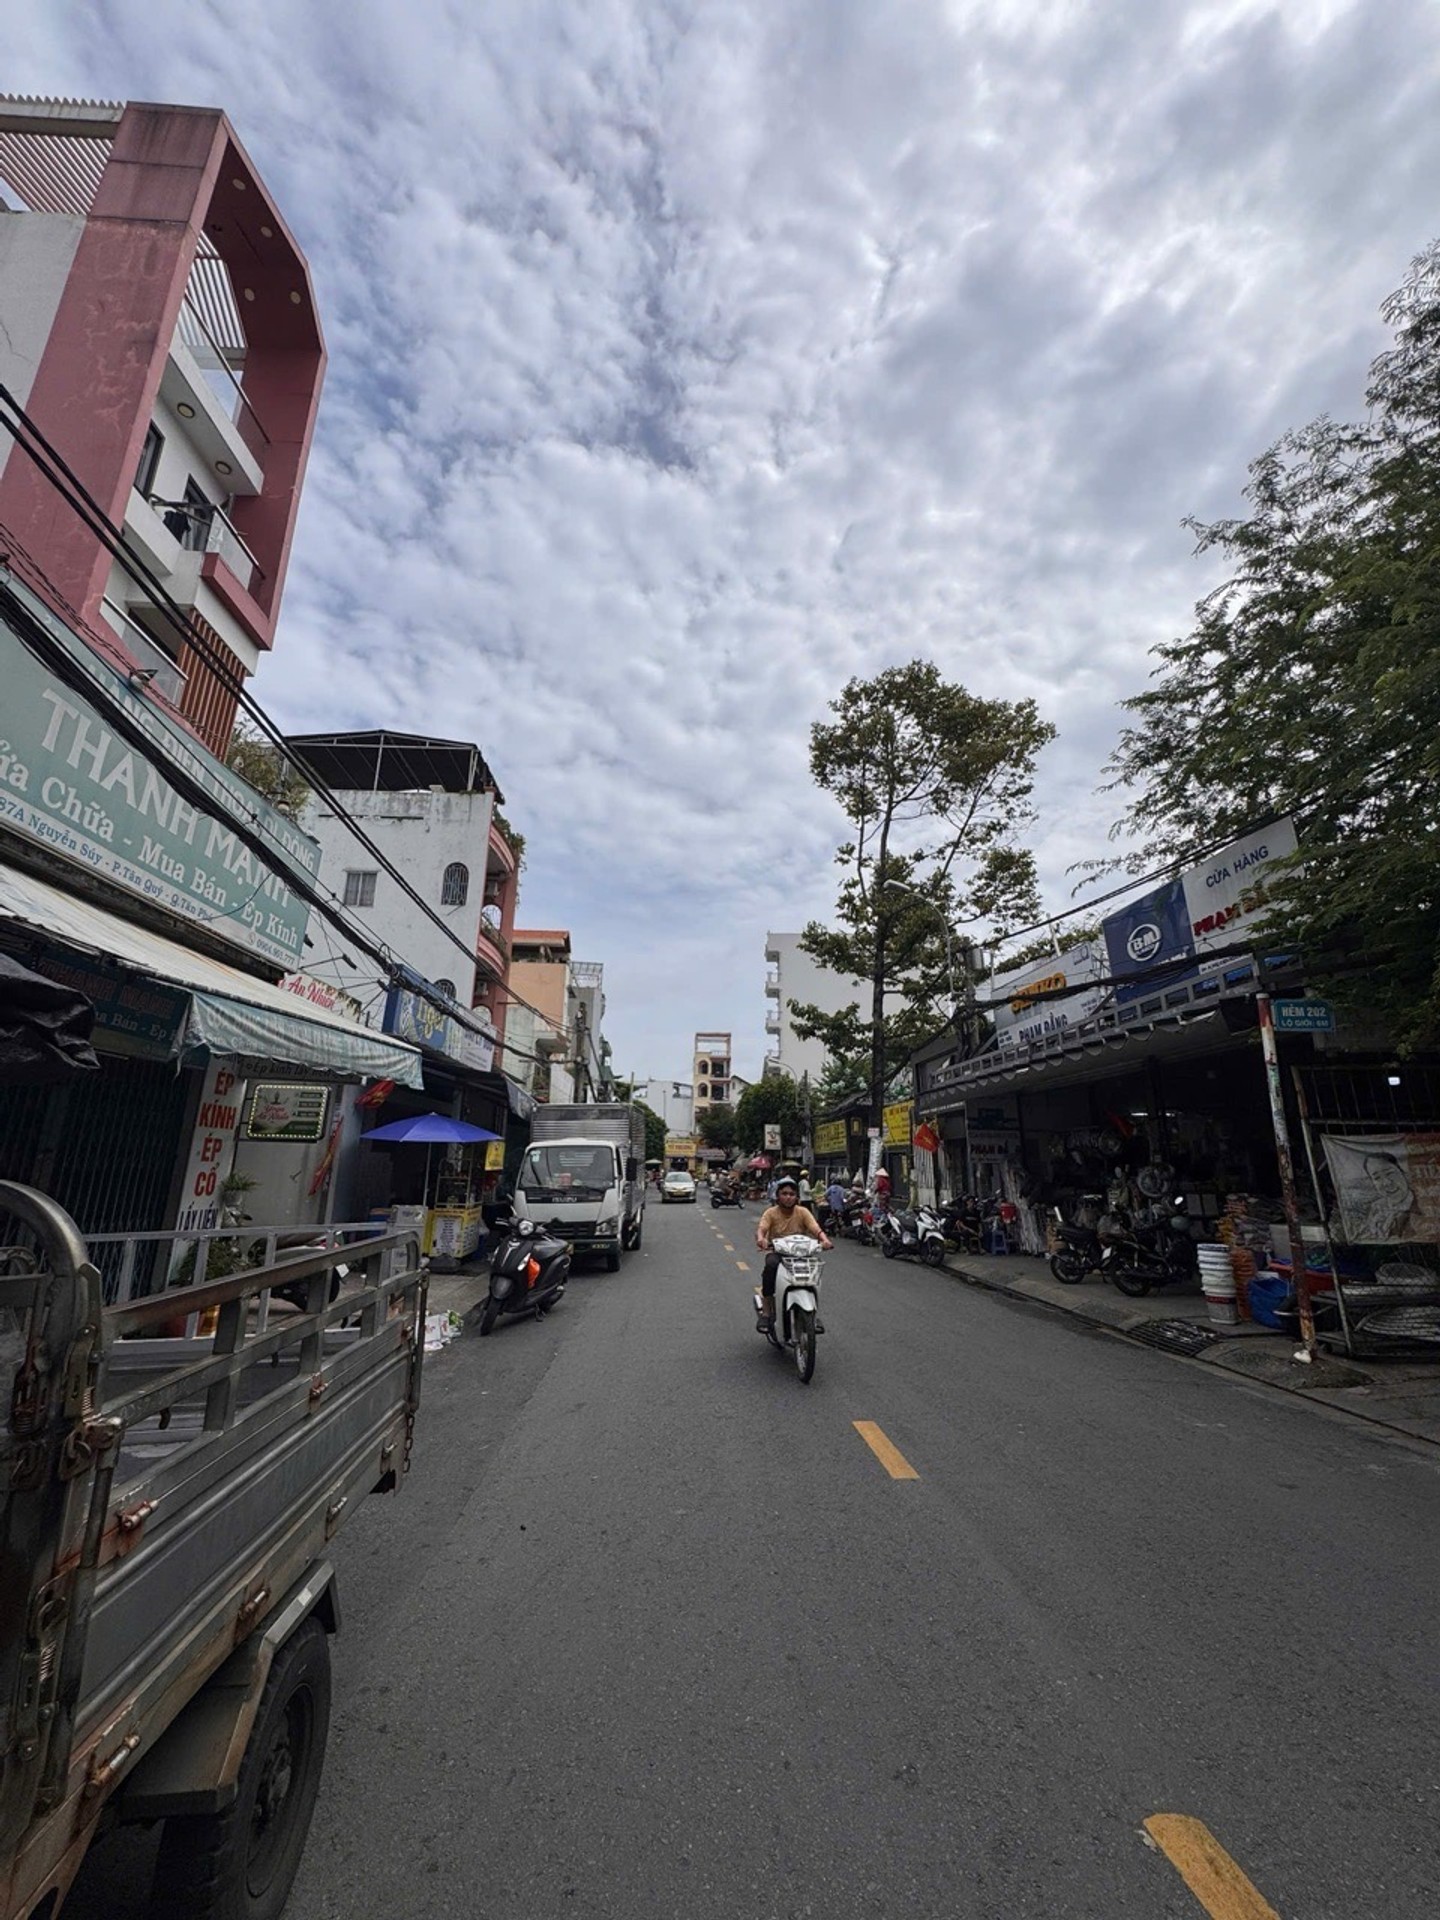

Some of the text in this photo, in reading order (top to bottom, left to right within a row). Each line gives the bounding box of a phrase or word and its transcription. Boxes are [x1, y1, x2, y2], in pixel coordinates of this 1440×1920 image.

[41, 688, 290, 909] THANH MẠNH
[28, 812, 78, 851] Nguyễn
[79, 842, 104, 867] Súy
[41, 776, 115, 843] Chữa
[138, 835, 185, 884] Mua
[190, 866, 227, 908] Bán
[265, 912, 299, 949] Kính
[1205, 845, 1270, 888] CỬA HÀNG
[1281, 1003, 1327, 1018] HẺM 202
[215, 1067, 235, 1096] ÉP
[198, 1099, 237, 1130] KÍNH
[201, 1132, 223, 1162] ÉP
[551, 1195, 578, 1203] ISUZU
